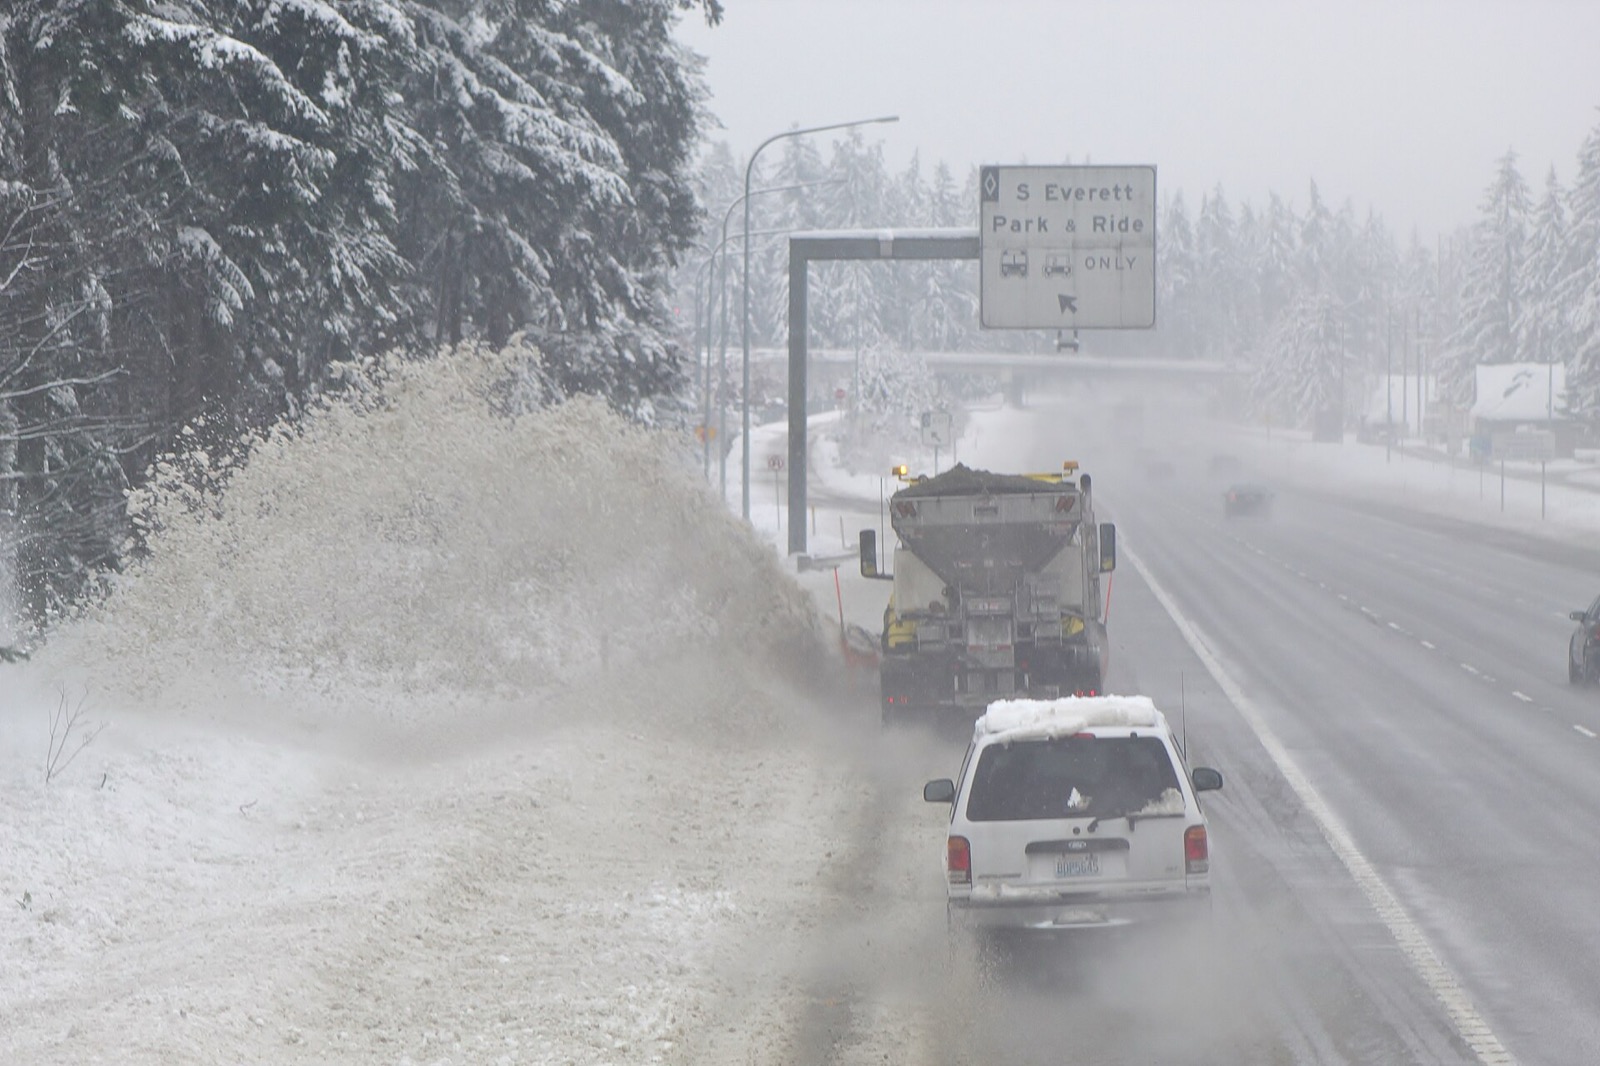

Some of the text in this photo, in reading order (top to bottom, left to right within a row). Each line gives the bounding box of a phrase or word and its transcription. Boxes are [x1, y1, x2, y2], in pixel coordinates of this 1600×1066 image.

[1016, 183, 1133, 201] S Everett
[992, 215, 1144, 232] Park & Ride
[1085, 256, 1137, 270] ONLY
